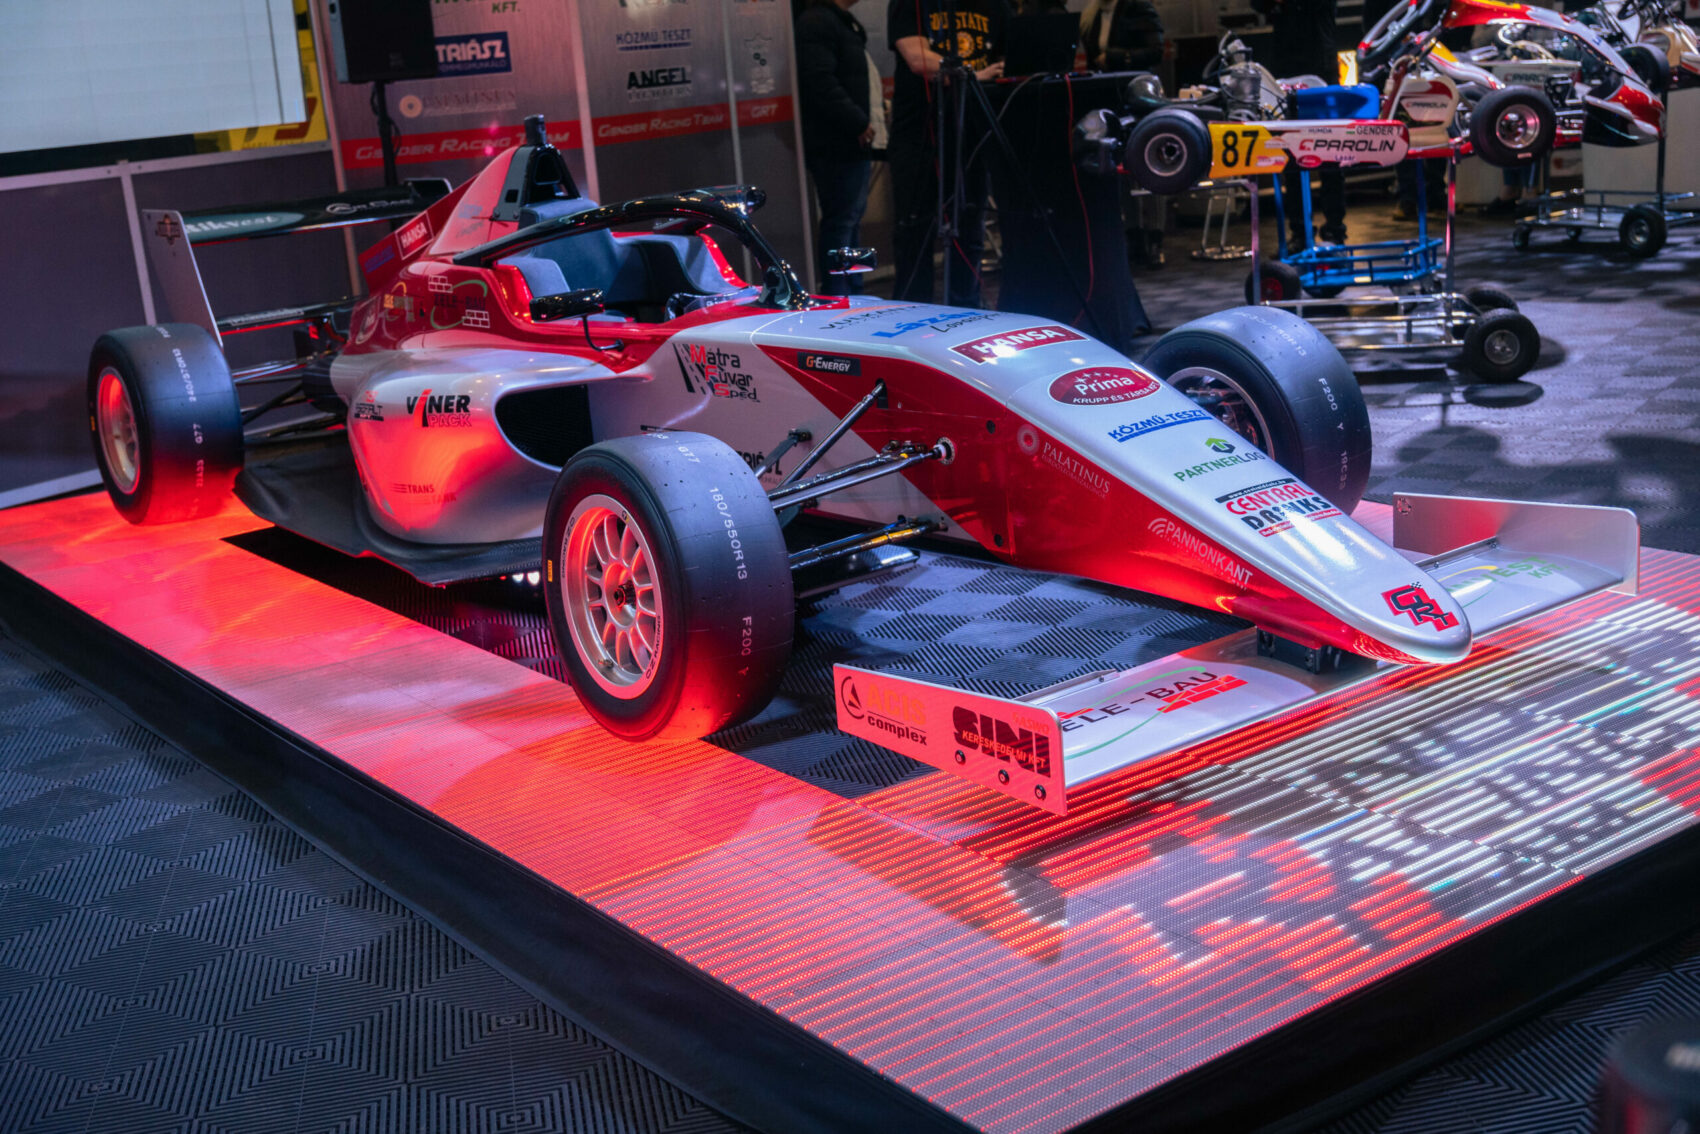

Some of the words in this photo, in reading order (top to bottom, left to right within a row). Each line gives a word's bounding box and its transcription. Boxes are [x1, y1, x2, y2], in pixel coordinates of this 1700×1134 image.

[434, 38, 507, 63] TRIÁSZ
[626, 67, 692, 90] ANGEL
[1312, 138, 1398, 152] PAROLIN
[1356, 126, 1395, 137] GENDER
[1221, 129, 1260, 168] 87
[400, 220, 428, 250] HANSA
[971, 327, 1064, 355] HANSA
[1072, 396, 1111, 405] KRUPP
[1110, 393, 1124, 404] ÉS
[1318, 377, 1338, 411] F200
[428, 413, 472, 428] PACK
[1043, 441, 1111, 494] PALATINUS
[1173, 450, 1267, 482] PARTNERLOG
[407, 483, 435, 495] TRANS
[1225, 483, 1316, 516] CENTRAL
[709, 486, 748, 580] 180/550R13
[1164, 521, 1254, 586] PANNONKANT
[866, 682, 927, 726] ACIS
[1062, 670, 1218, 733] ELE-BAU
[867, 713, 928, 746] complex
[962, 729, 1028, 762] KERESKEDELMI
